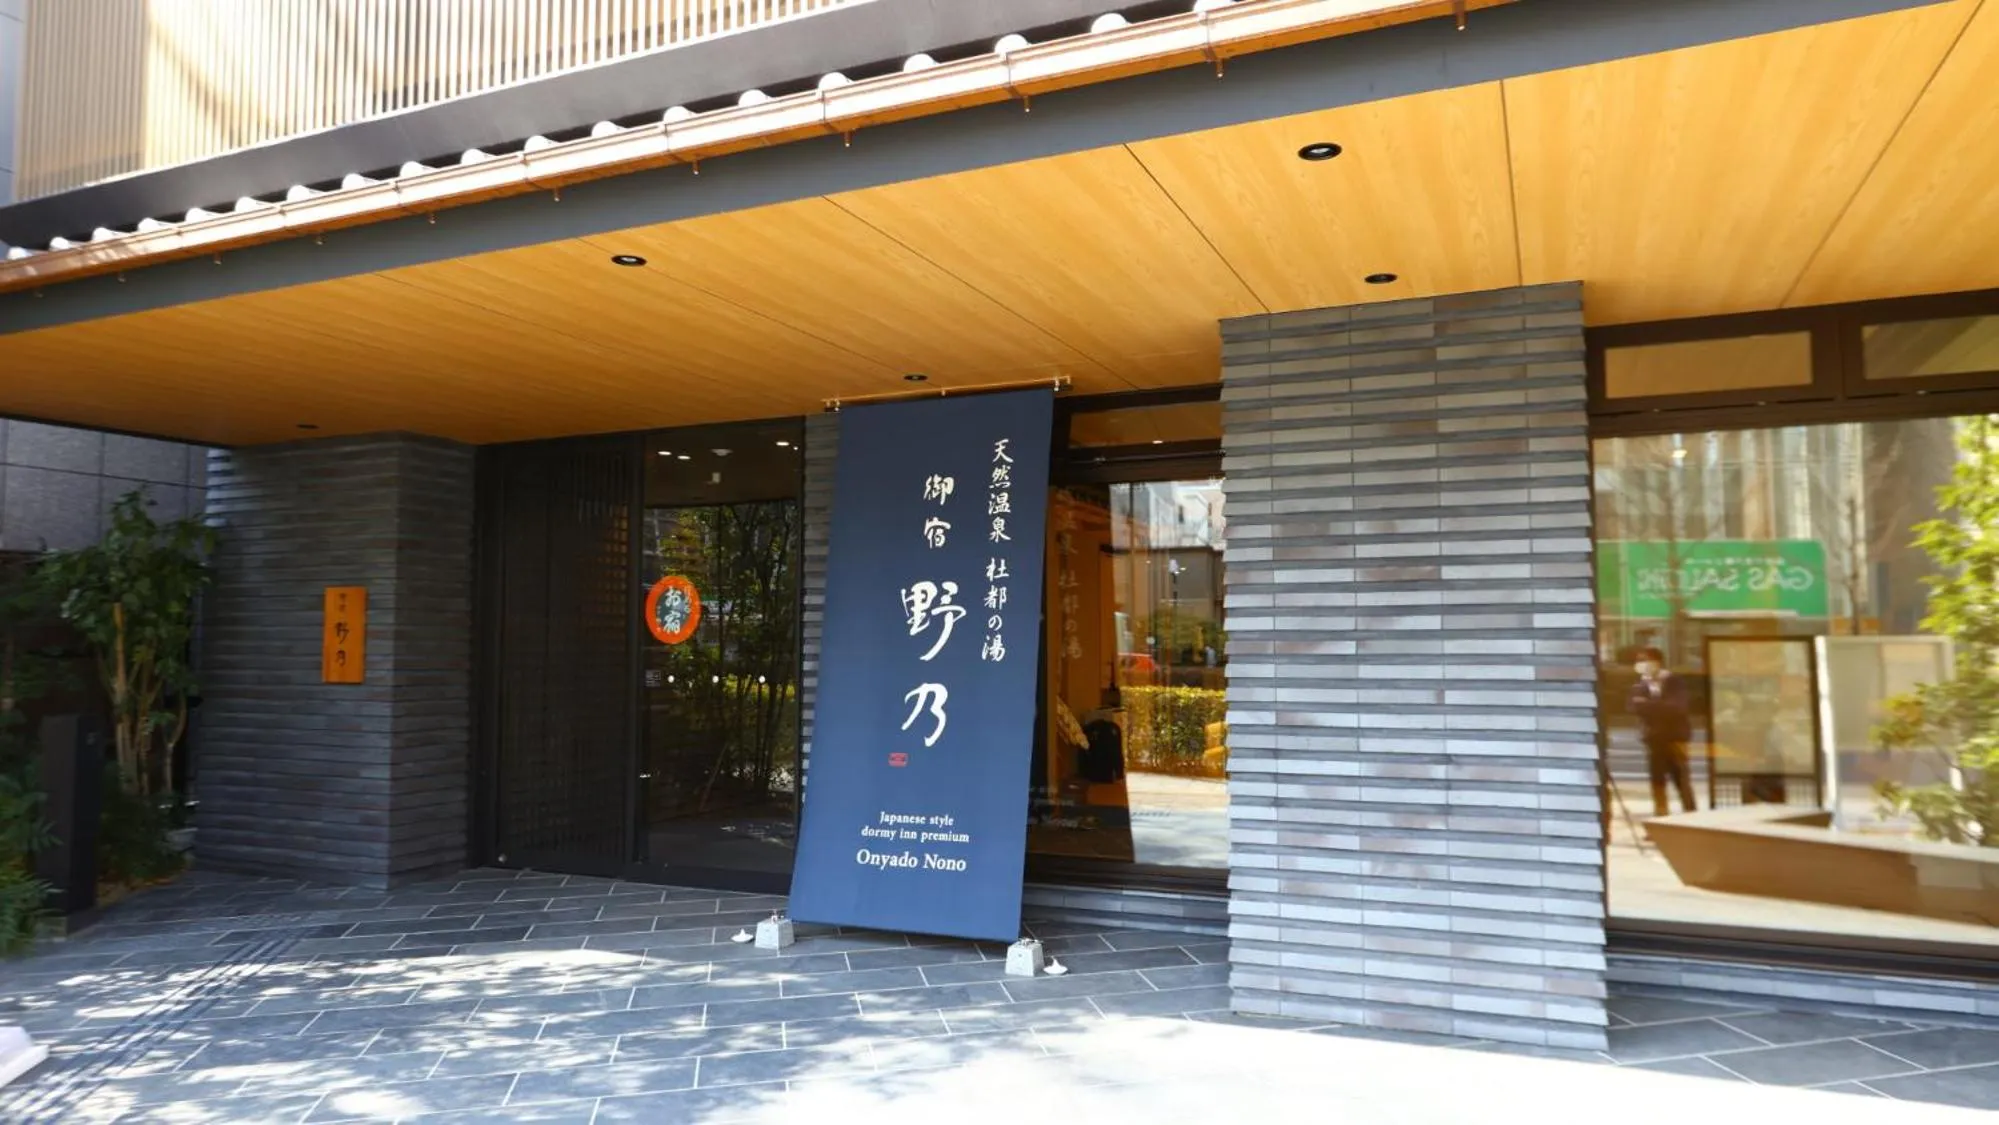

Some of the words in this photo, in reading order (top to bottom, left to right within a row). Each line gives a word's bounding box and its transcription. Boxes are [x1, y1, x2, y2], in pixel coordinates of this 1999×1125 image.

[923, 474, 954, 549] 御宿
[988, 437, 1014, 543] 天然温泉
[981, 557, 1010, 662] 杜都の湯
[901, 581, 967, 747] 野乃
[861, 826, 896, 840] dormy
[900, 828, 917, 840] inn
[921, 830, 970, 843] premium
[880, 811, 926, 826] Japanese
[930, 814, 954, 828] style
[856, 849, 918, 870] Onyado
[923, 853, 967, 872] Nono
